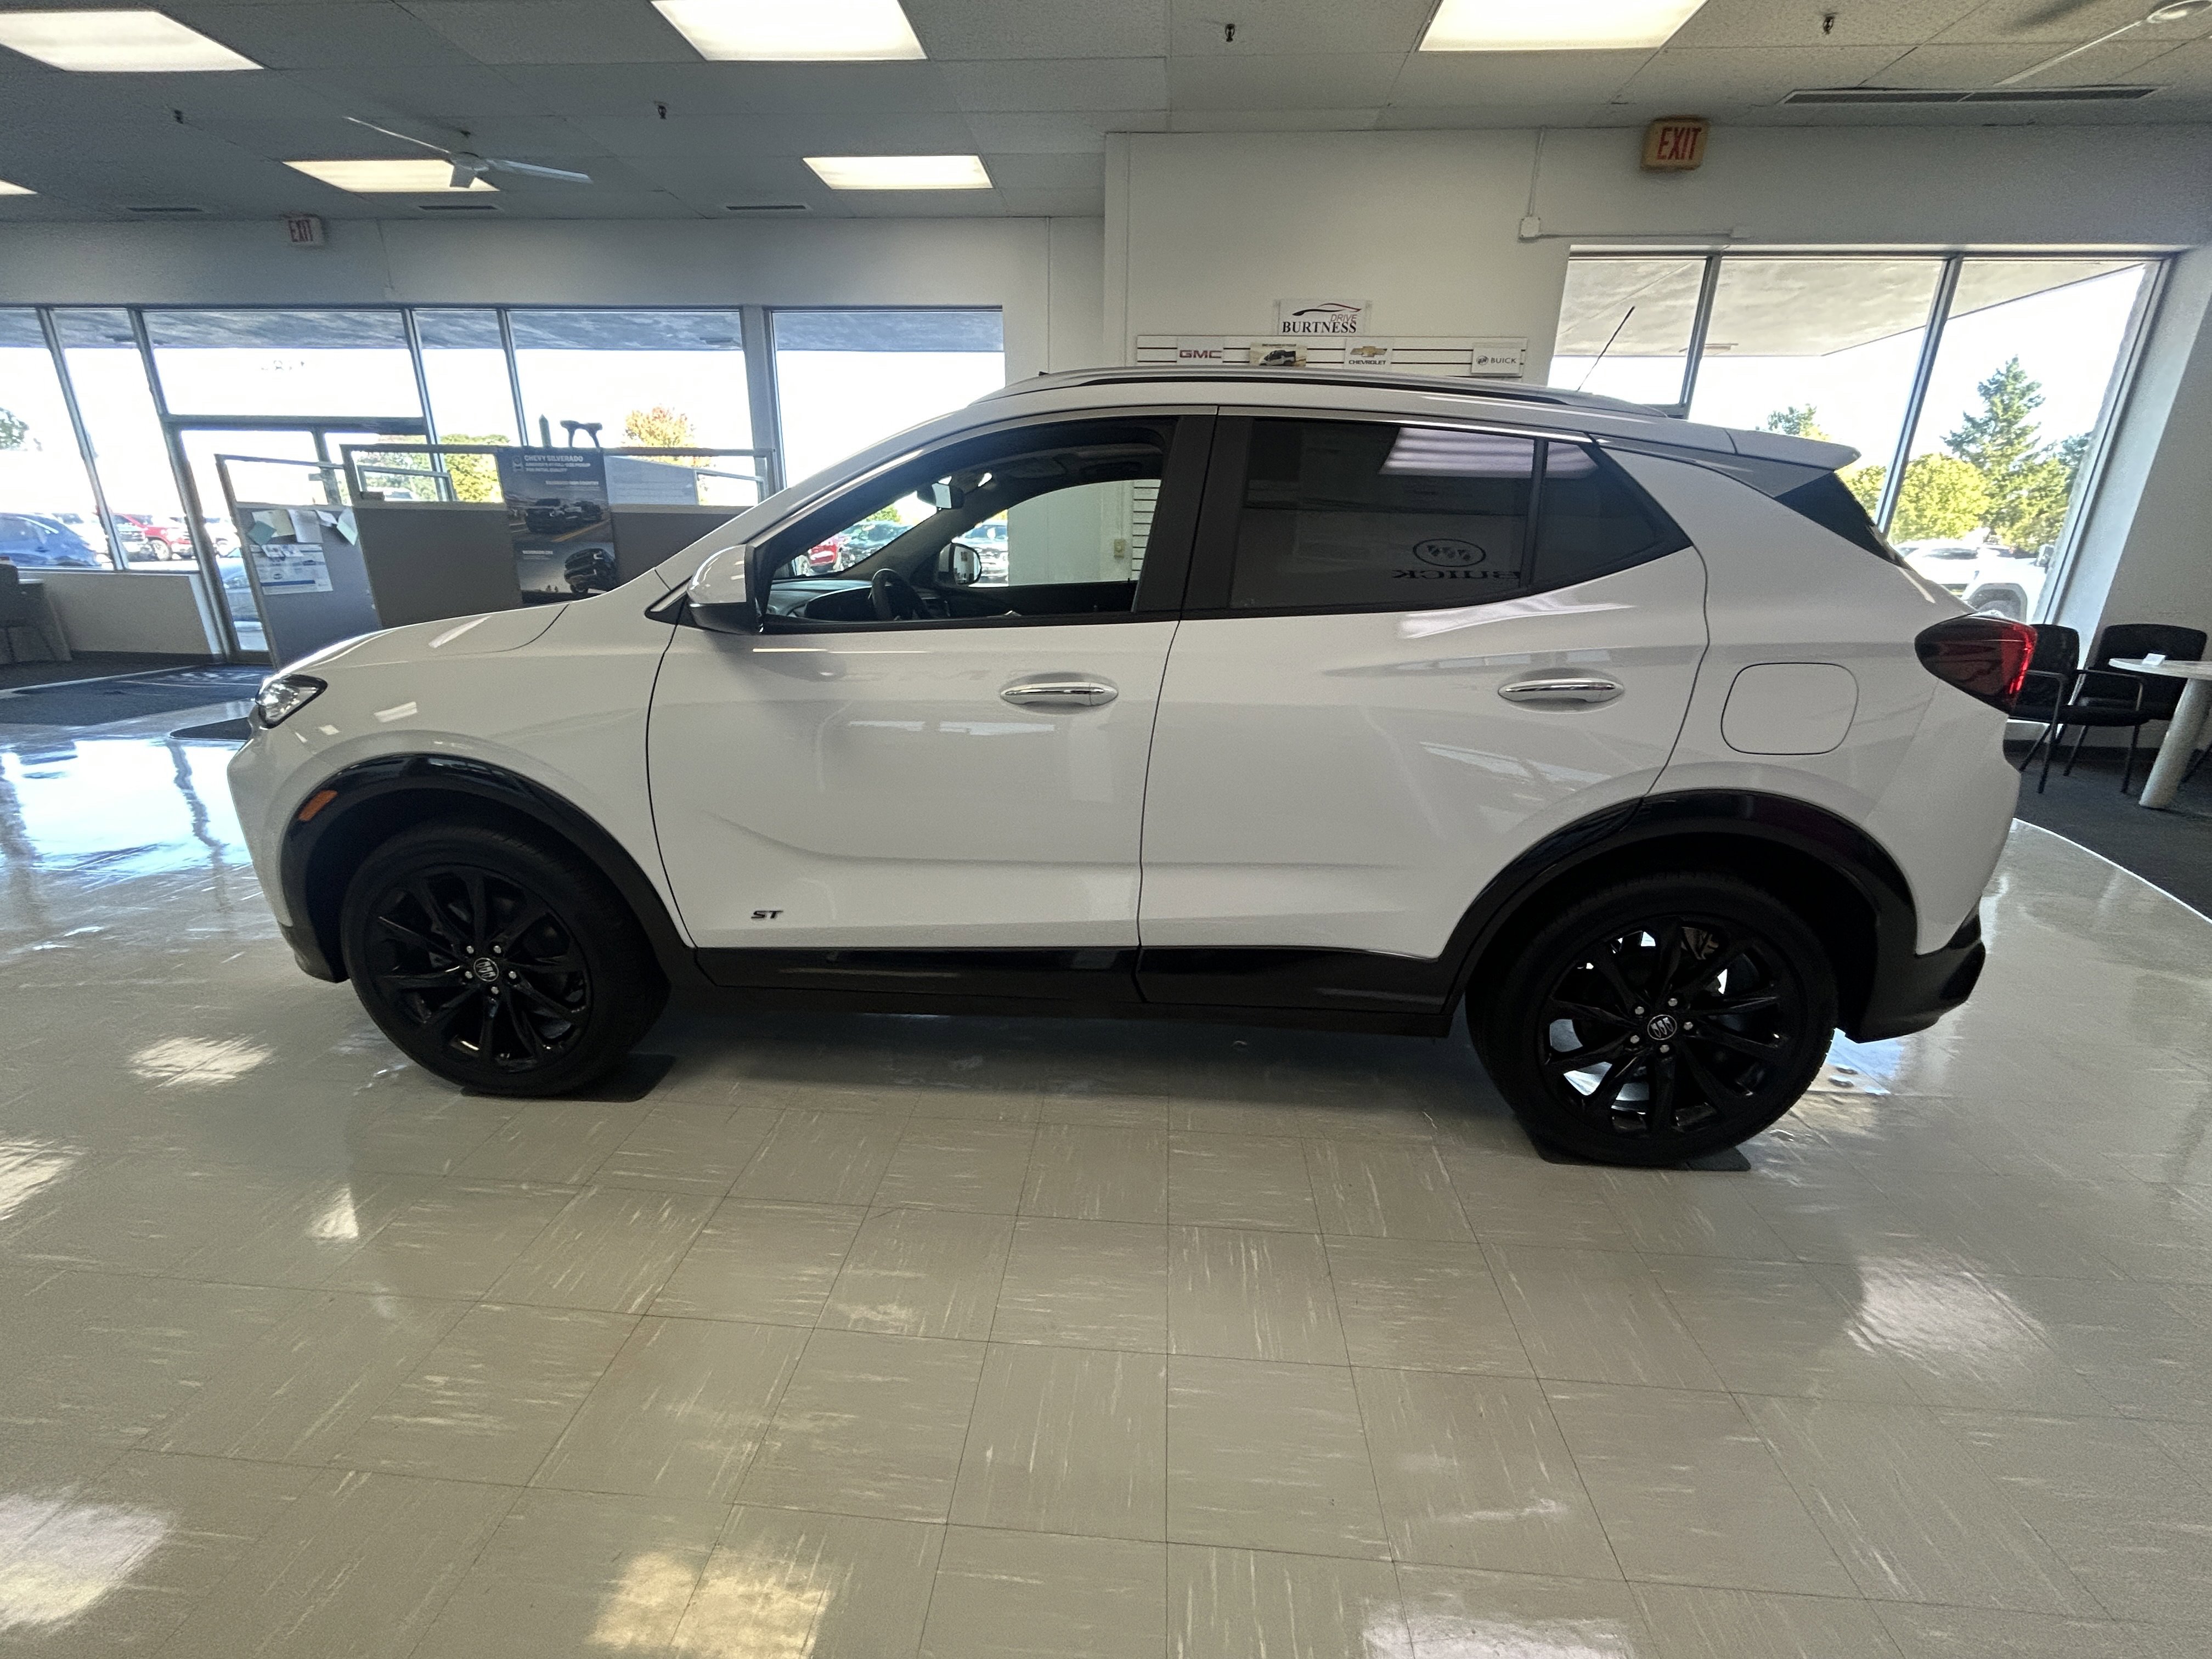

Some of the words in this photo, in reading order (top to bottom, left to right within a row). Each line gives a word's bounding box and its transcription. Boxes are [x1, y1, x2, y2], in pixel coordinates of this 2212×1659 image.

[1657, 127, 1702, 160] EXIT
[288, 219, 314, 242] EXIT
[1330, 314, 1357, 323] DRIVE
[1282, 321, 1357, 334] BURTNESS
[1179, 349, 1222, 359] GMC
[751, 910, 783, 919] ST
